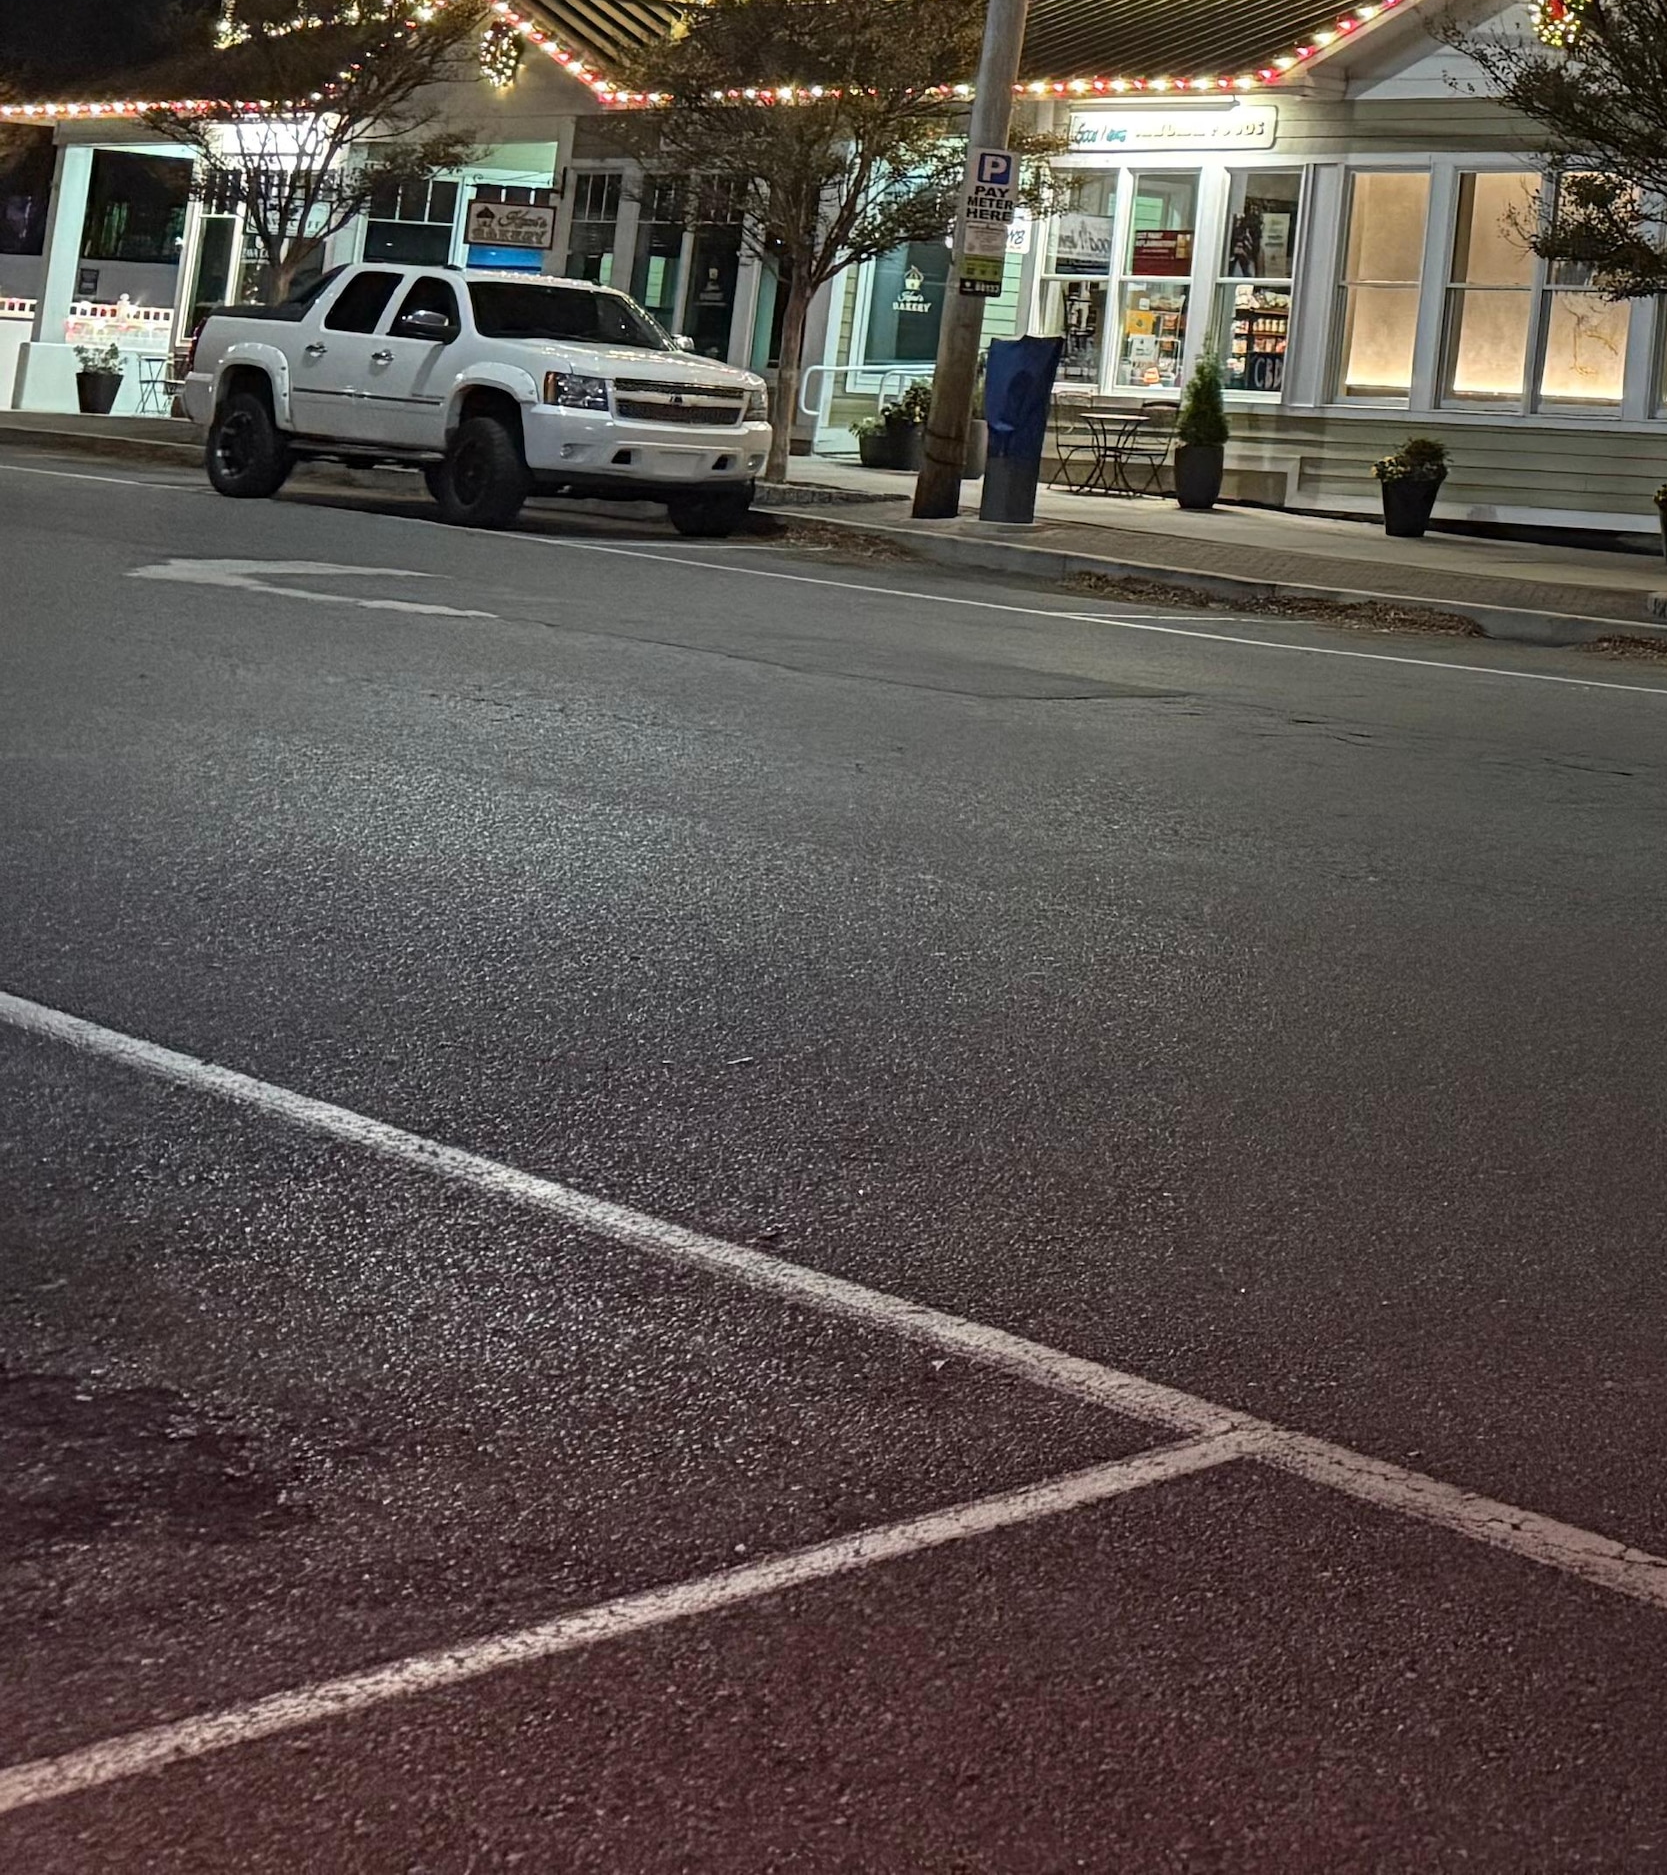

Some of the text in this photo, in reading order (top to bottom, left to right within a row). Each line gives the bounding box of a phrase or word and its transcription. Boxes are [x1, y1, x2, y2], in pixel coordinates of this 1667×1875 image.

[982, 156, 1008, 182] P
[974, 185, 1010, 198] PAY
[967, 196, 1014, 210] METER
[966, 208, 1013, 222] HERE
[892, 301, 932, 313] BAKERY
